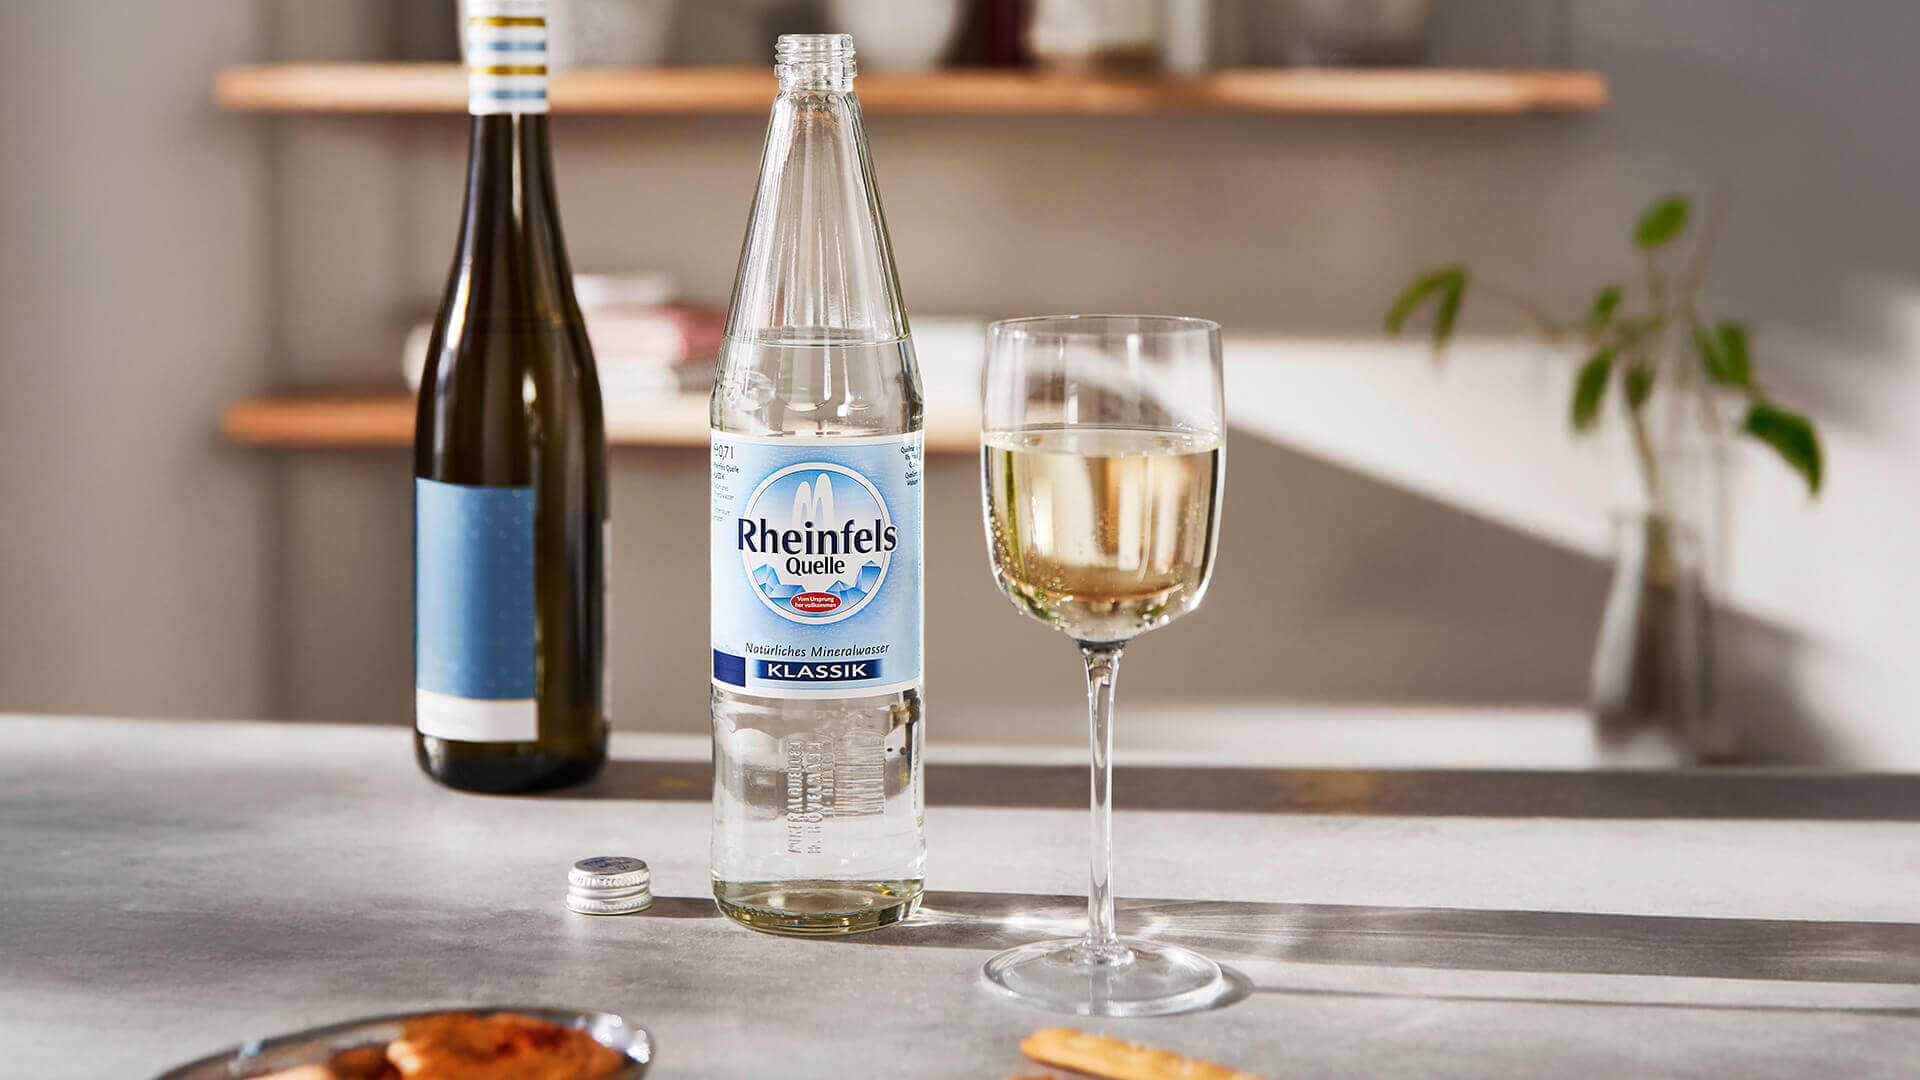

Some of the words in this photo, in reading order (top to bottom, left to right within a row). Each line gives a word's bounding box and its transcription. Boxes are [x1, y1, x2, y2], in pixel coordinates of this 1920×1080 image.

[738, 518, 897, 555] Rheinfels
[785, 557, 845, 576] Quelle
[745, 641, 806, 657] Natürliches
[811, 643, 890, 657] Mineralwasser
[767, 663, 867, 679] KLASSIK
